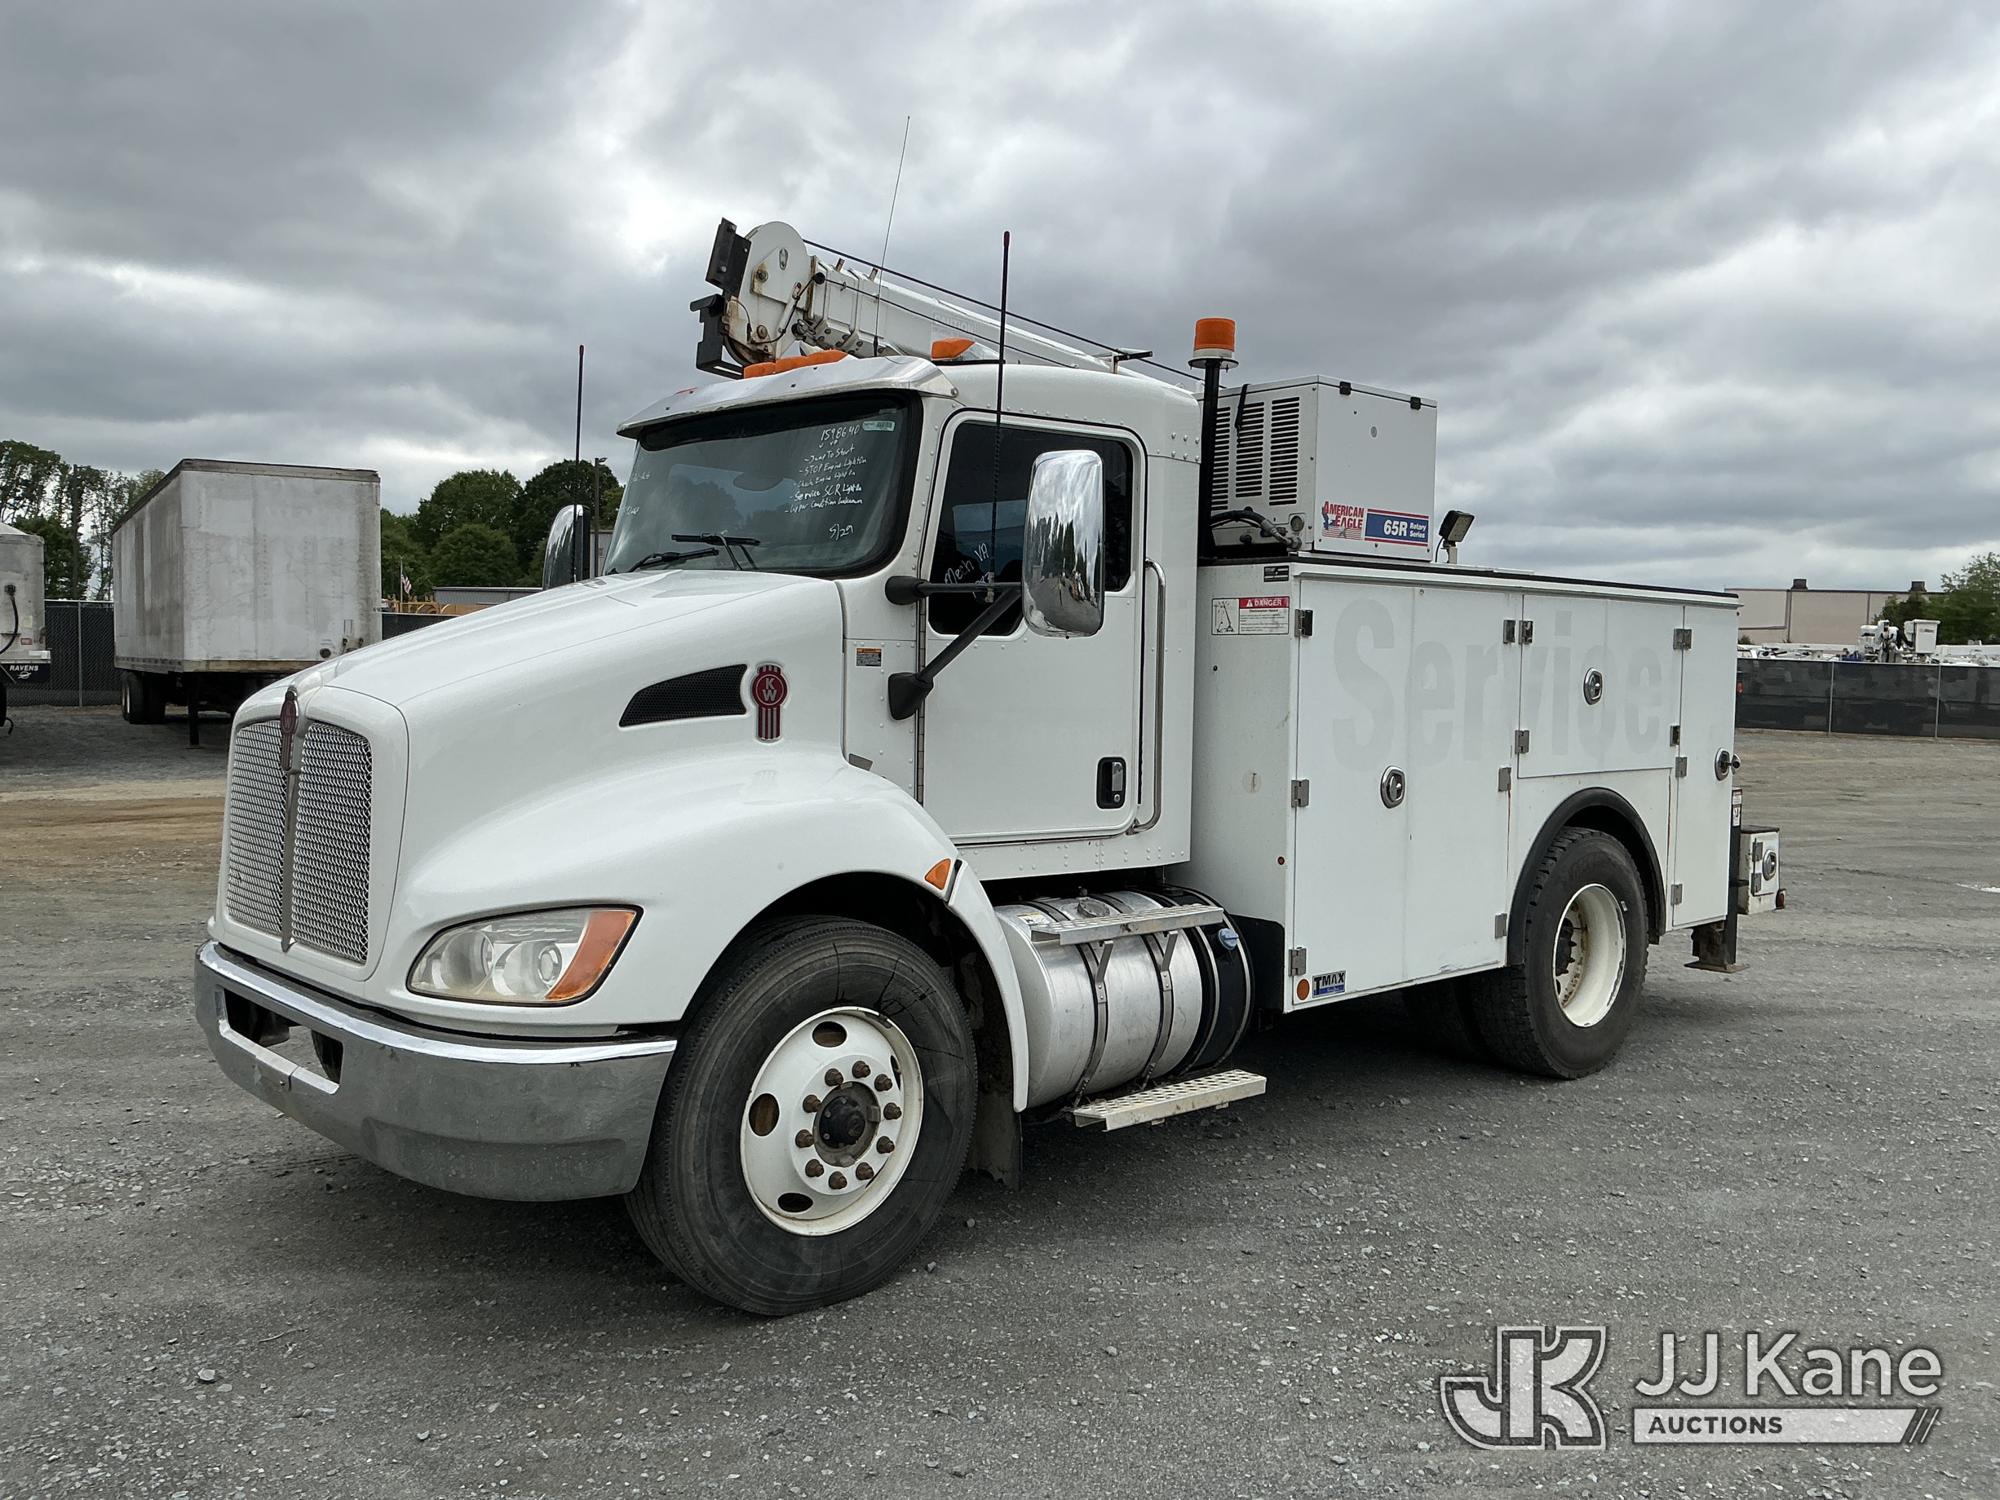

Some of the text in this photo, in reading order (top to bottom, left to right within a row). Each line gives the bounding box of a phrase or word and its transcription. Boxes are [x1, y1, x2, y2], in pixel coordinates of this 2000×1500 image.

[1323, 501, 1365, 519] AMERICAN
[1335, 516, 1364, 530] EAGLE
[1383, 519, 1408, 537] 65R
[1409, 522, 1427, 532] Rotary
[1409, 530, 1426, 539] Series
[1253, 598, 1283, 608] DANGER
[9, 664, 39, 672] RAVENS
[1331, 598, 1665, 772] Service
[1313, 972, 1346, 996] TMAX
